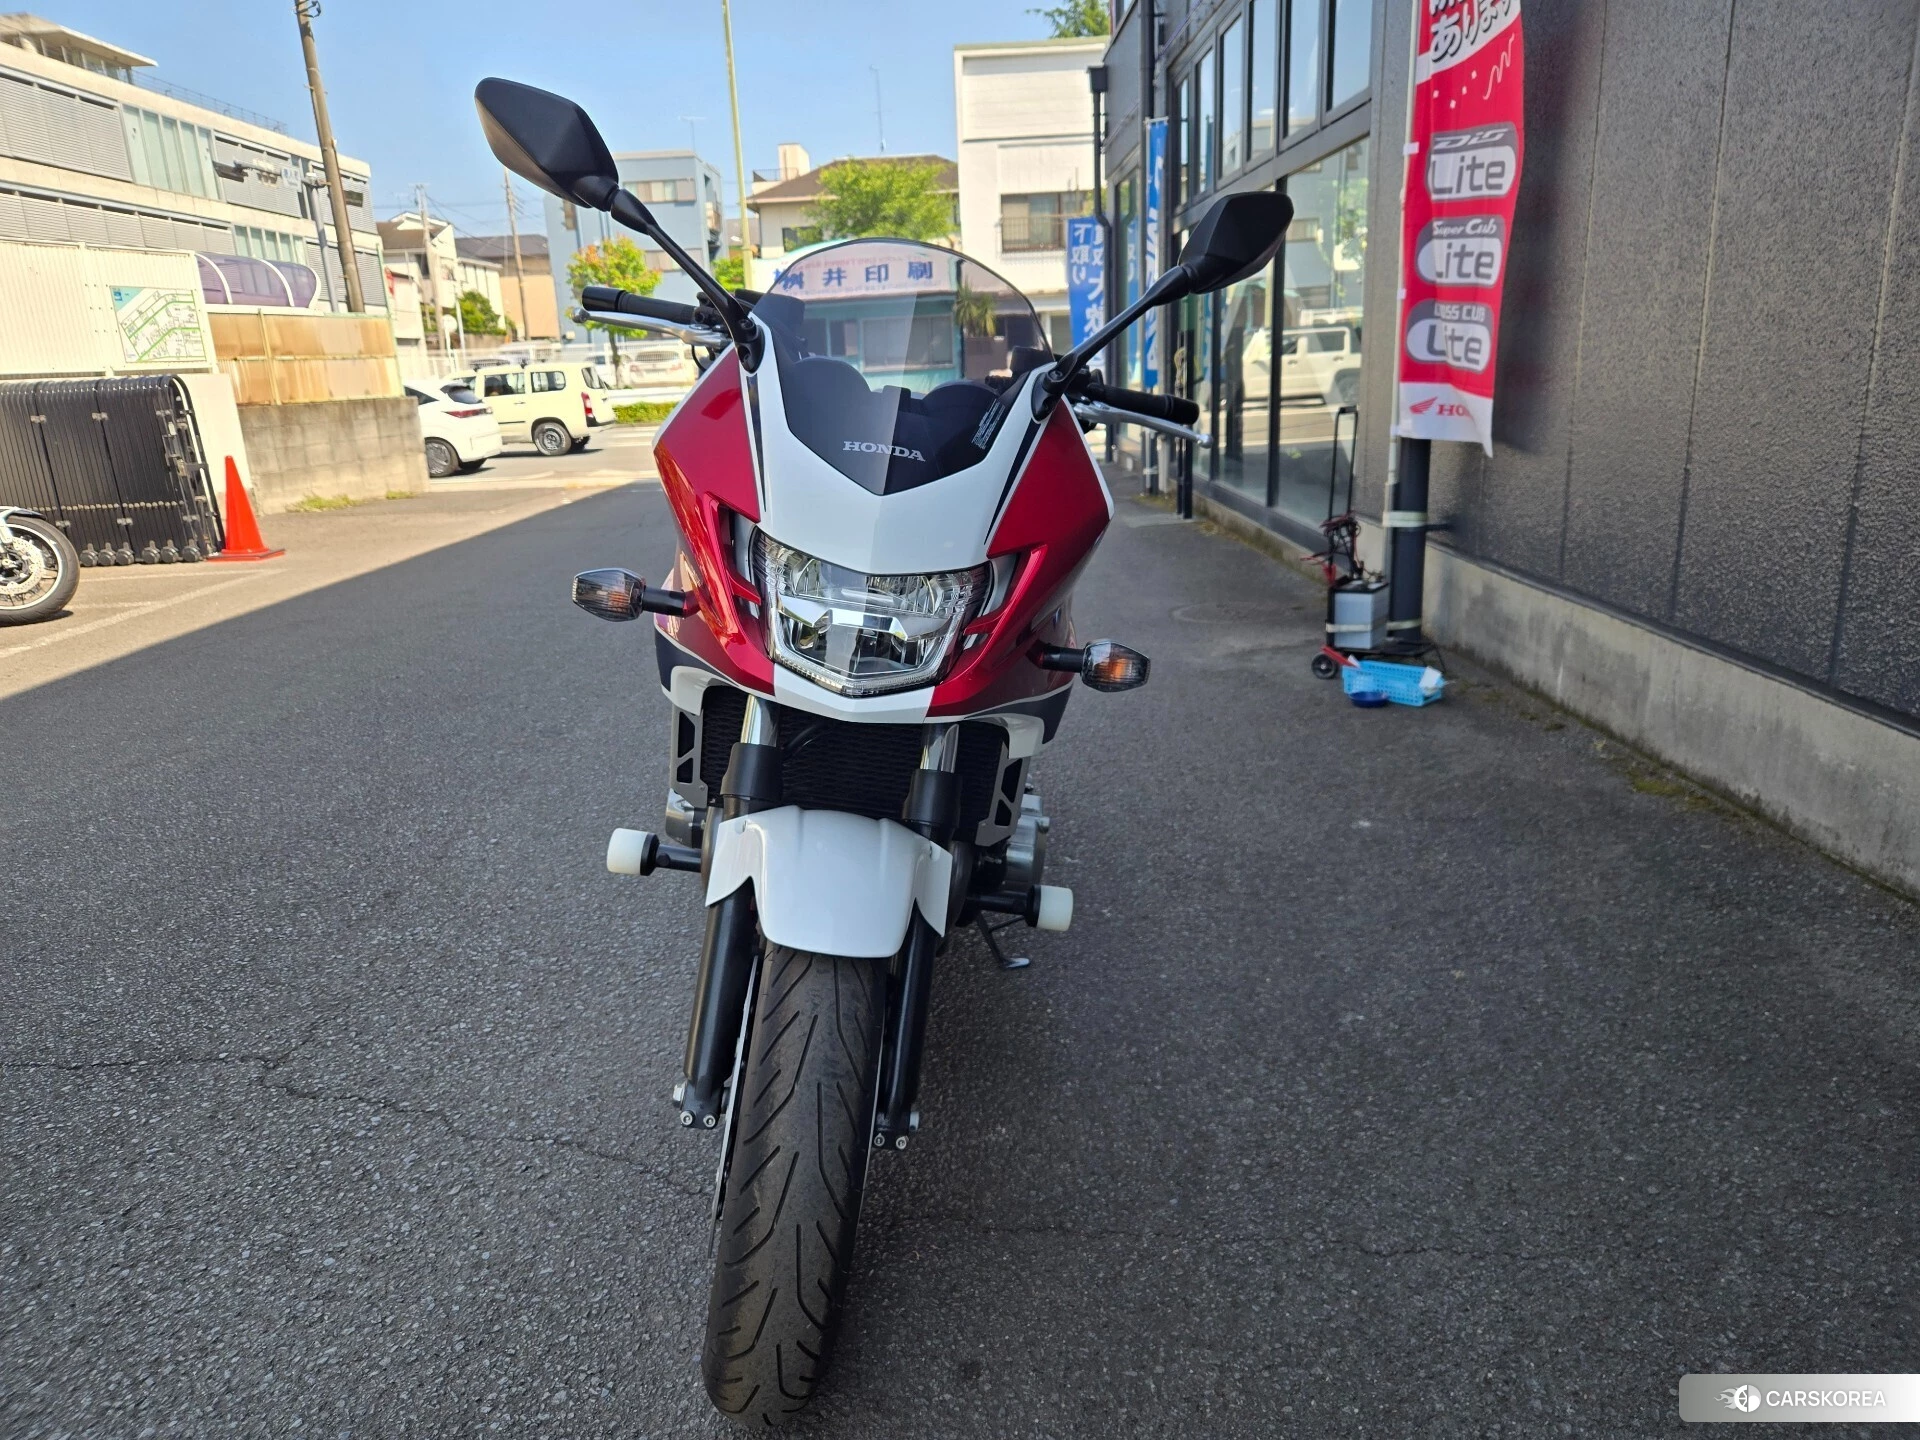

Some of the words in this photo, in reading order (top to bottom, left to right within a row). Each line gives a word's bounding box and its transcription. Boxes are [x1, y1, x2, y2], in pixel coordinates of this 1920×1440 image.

[1431, 156, 1505, 195] Lite
[1465, 218, 1497, 235] Cub
[1436, 242, 1494, 280] ite
[1462, 305, 1485, 322] CUB
[843, 441, 926, 462] HONDA
